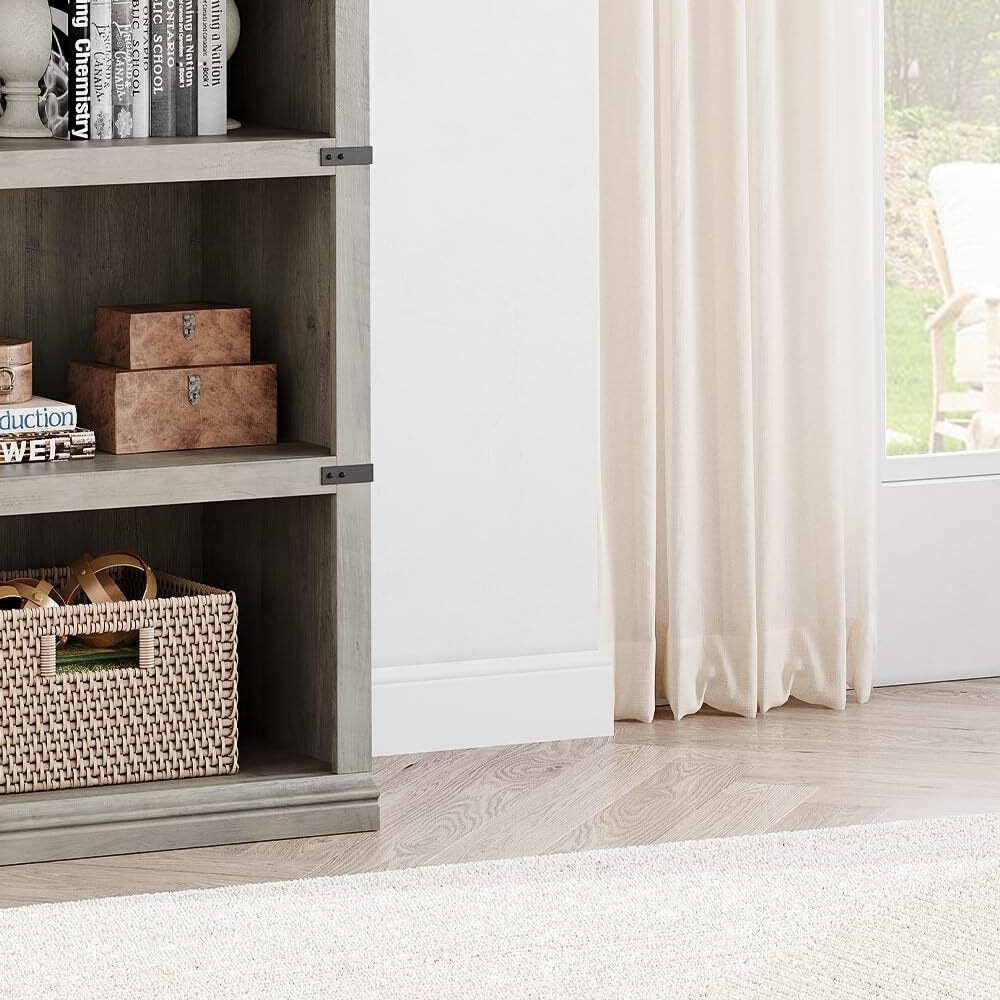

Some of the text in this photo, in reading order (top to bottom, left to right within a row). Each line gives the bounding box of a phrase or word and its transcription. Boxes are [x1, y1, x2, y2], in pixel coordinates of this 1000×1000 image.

[185, 34, 193, 42] a
[211, 33, 220, 41] a
[132, 40, 140, 97] SCHOOL
[153, 33, 163, 95] SCHOOL
[185, 45, 194, 88] Nation
[211, 44, 222, 87] Nation
[72, 39, 91, 140] Chemistry
